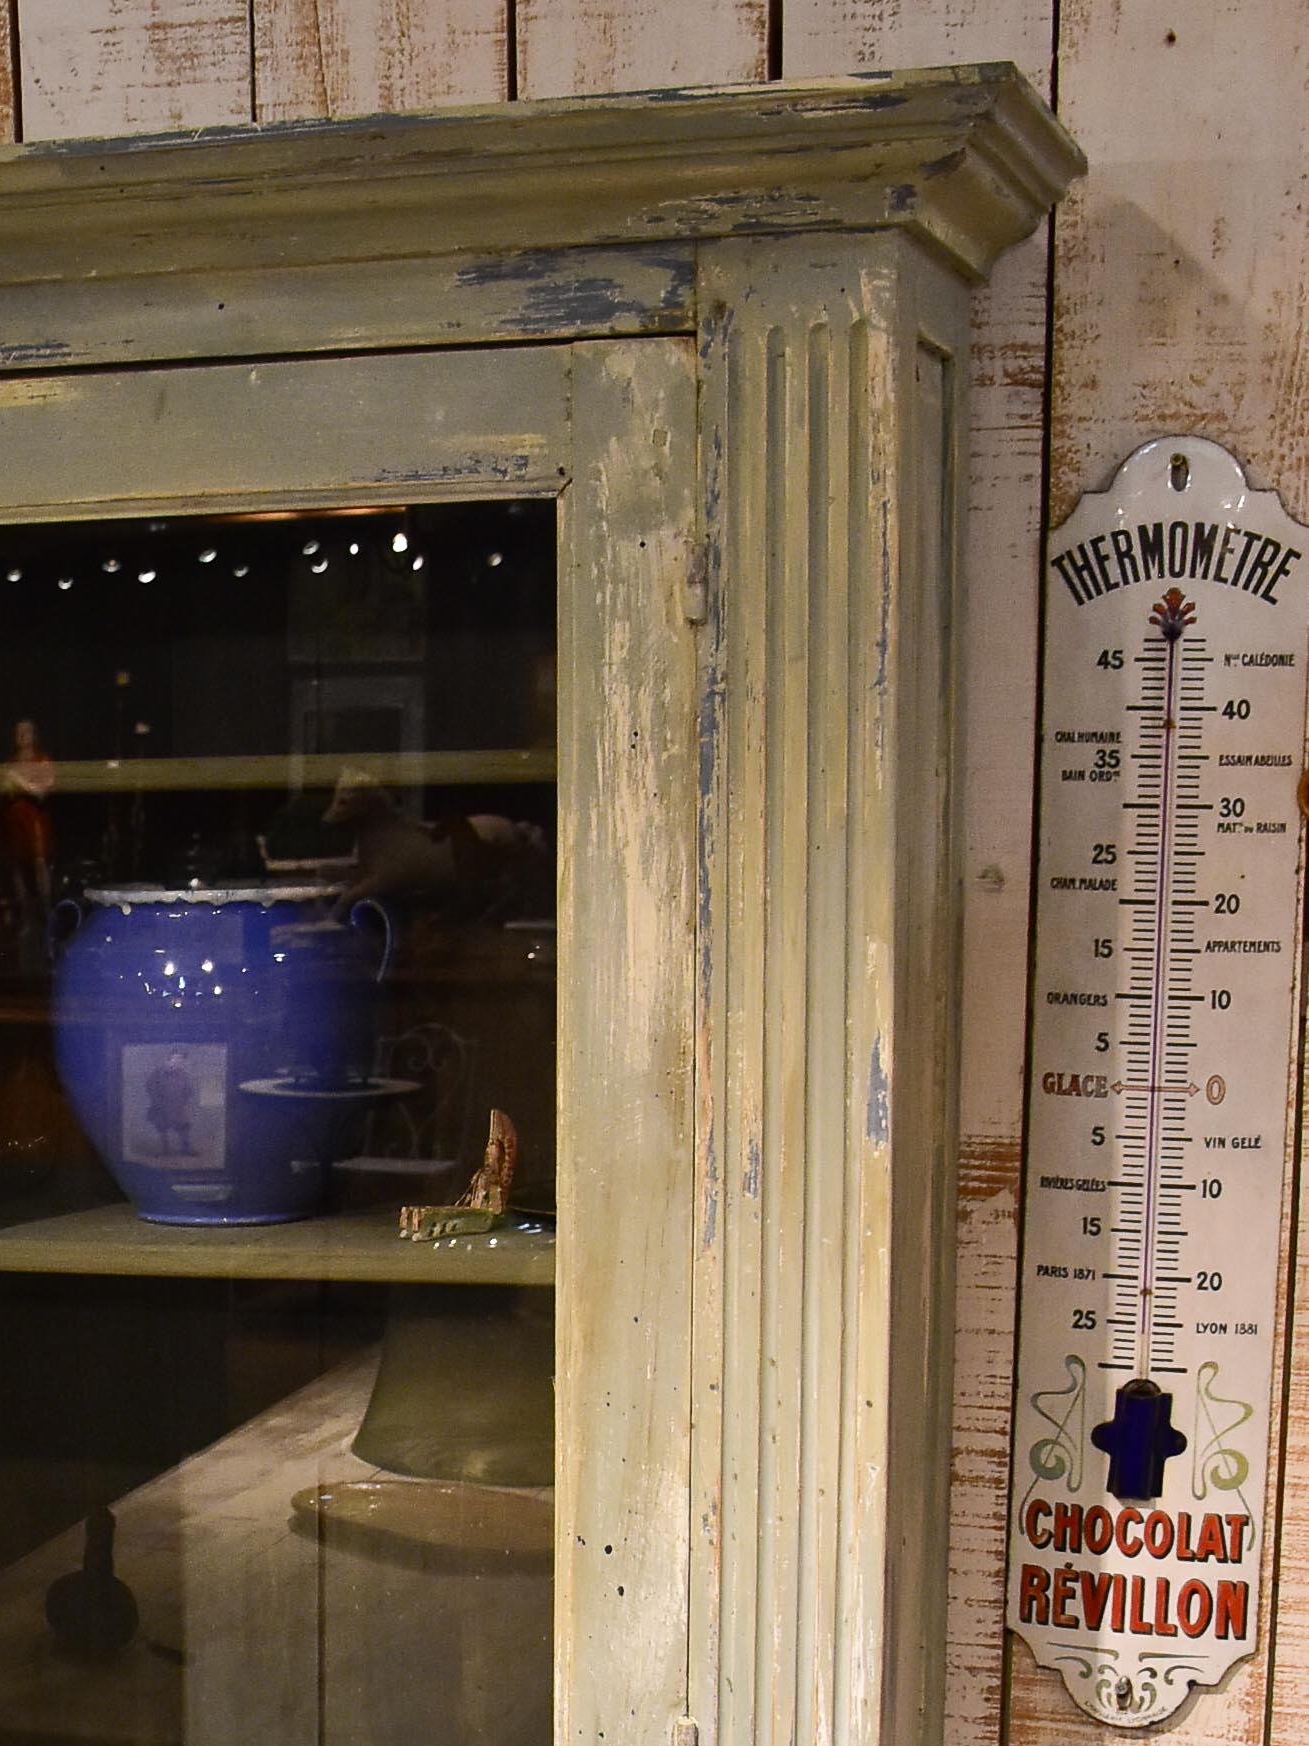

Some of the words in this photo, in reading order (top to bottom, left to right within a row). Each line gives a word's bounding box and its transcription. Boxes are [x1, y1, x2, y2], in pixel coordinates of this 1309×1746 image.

[1097, 649, 1124, 670] 45
[1242, 652, 1295, 667] CALÉDONIE
[1222, 699, 1251, 720] 40
[1094, 749, 1121, 769] 35
[1219, 797, 1245, 818] 30
[1256, 822, 1287, 833] RAISIN
[1091, 843, 1117, 865] 25
[1214, 893, 1240, 915] 20
[1094, 938, 1114, 959] 15
[1205, 940, 1282, 954] APPARTEMENTS
[1046, 991, 1108, 1007] ORANGERS
[1211, 989, 1231, 1010] 10
[1095, 1032, 1110, 1052] 5
[1042, 1072, 1109, 1098] GLACE
[1206, 1075, 1226, 1105] 0
[1091, 1126, 1105, 1146] 5
[1204, 1137, 1226, 1149] VIN
[1231, 1135, 1262, 1149] GELÉ
[1202, 1179, 1222, 1199] 10
[1082, 1216, 1102, 1237] 15
[1036, 1265, 1069, 1279] PARIS
[1073, 1268, 1096, 1281] 1871
[1196, 1271, 1223, 1291] 20
[1072, 1309, 1097, 1330] 25
[1196, 1322, 1228, 1335] LYON
[1025, 1498, 1250, 1564] CHOCOLAT
[1019, 1562, 1249, 1641] RÉVILLON
